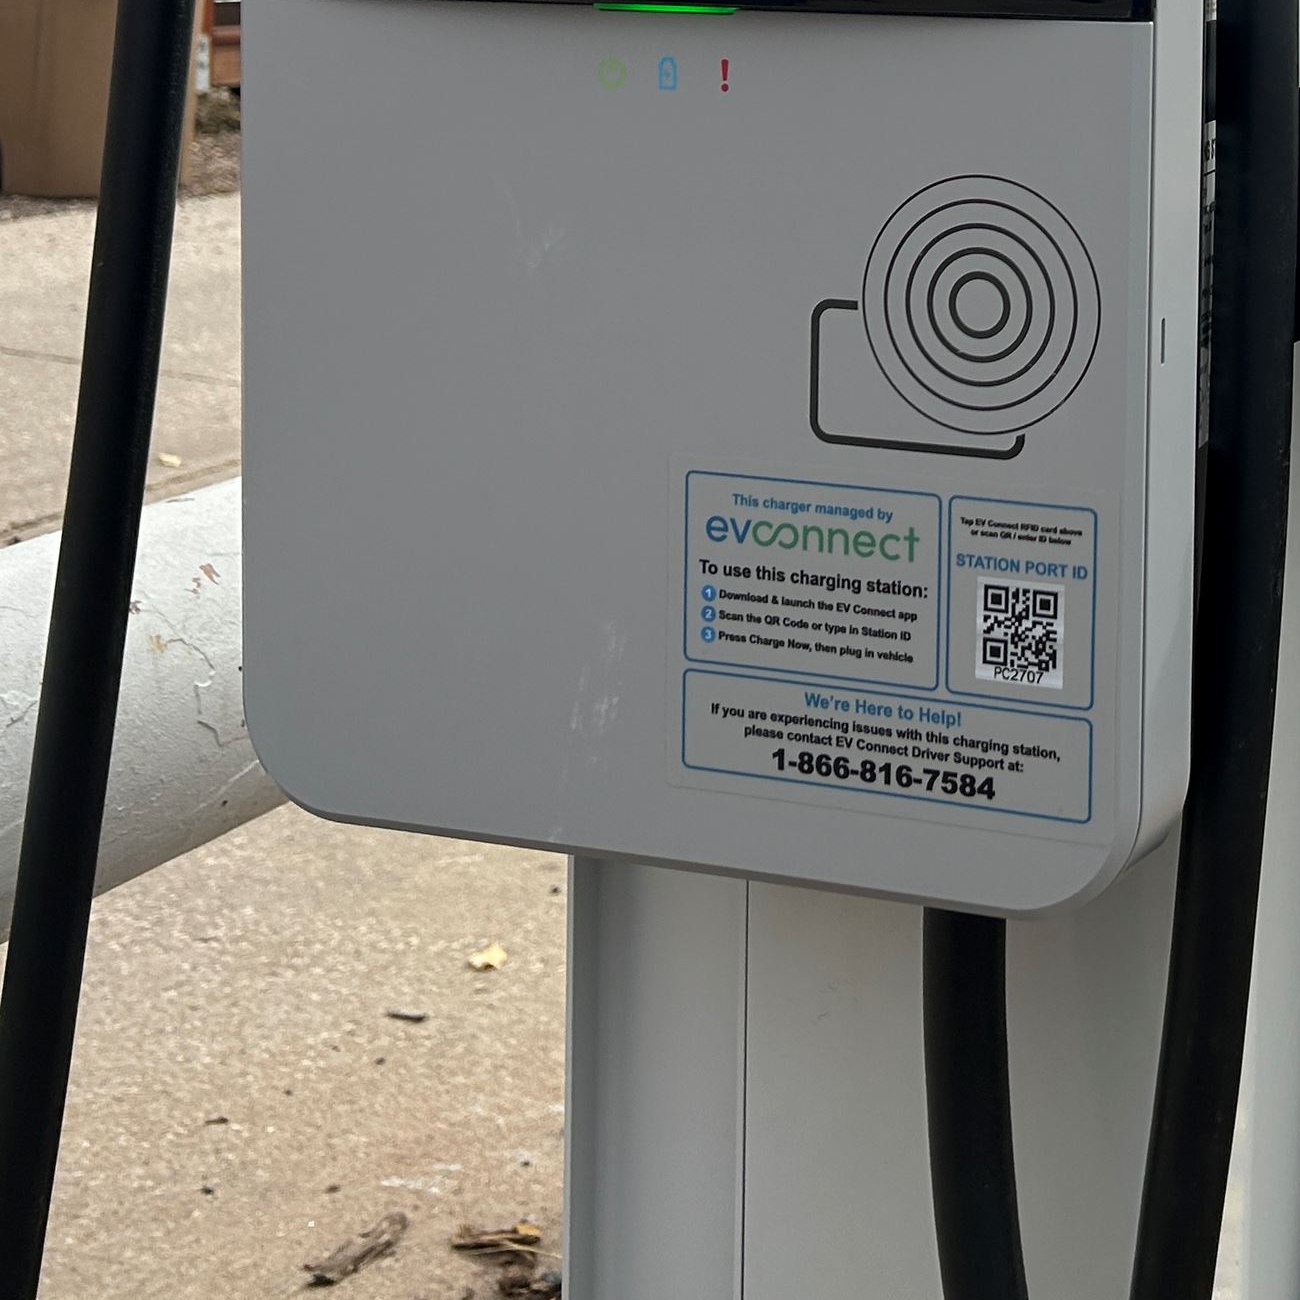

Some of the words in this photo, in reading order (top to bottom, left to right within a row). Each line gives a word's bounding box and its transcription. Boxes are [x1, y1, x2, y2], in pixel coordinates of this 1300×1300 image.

[732, 494, 760, 508] This
[762, 497, 812, 514] charger
[815, 504, 874, 520] managed
[878, 507, 894, 524] by
[706, 515, 920, 562] evconnect
[960, 516, 974, 526] Tap
[975, 518, 986, 527] EV
[988, 519, 1019, 530] Connect
[1020, 522, 1039, 532] RFID
[1041, 526, 1058, 534] card
[1060, 527, 1082, 536] above
[699, 559, 718, 576] To
[723, 564, 751, 578] use
[756, 565, 786, 582] this
[790, 569, 862, 594] charging
[866, 578, 929, 598] station:
[956, 553, 1020, 573] STATION
[1025, 560, 1068, 578] PORT
[1072, 565, 1088, 580] ID
[719, 589, 769, 604] Download
[771, 596, 779, 605] &
[781, 596, 815, 610] launch
[817, 600, 834, 612] the
[836, 602, 851, 614] EV
[853, 604, 896, 618] Connect
[898, 611, 918, 622] app
[718, 610, 744, 622] Scan
[746, 612, 762, 624] the
[764, 614, 780, 626] QR
[783, 617, 809, 630] Code
[811, 621, 823, 631] or
[824, 622, 847, 634] type
[849, 624, 859, 635] in
[861, 626, 898, 640] Station
[900, 630, 912, 641] ID
[718, 630, 746, 643] Press
[749, 634, 785, 648] Charge
[787, 638, 812, 652] Now,
[814, 642, 837, 654] then
[840, 645, 862, 658] plug
[864, 647, 874, 658] in
[877, 650, 914, 663] vehicle
[994, 666, 1044, 685] PC2707
[804, 692, 850, 712] We're
[855, 698, 893, 717] Here
[898, 704, 914, 720] to
[919, 707, 962, 728] Help!
[711, 702, 720, 714] If
[722, 706, 745, 718] you
[748, 710, 768, 720] are
[770, 713, 849, 734] experiencing
[852, 720, 892, 738] issues
[896, 726, 922, 742] with
[926, 731, 949, 745] this
[952, 734, 1009, 756] charging
[1012, 744, 1060, 762] station,
[744, 725, 784, 740] please
[787, 732, 832, 746] contact
[836, 736, 853, 748] EV
[856, 738, 908, 756] Connect
[912, 746, 950, 762] Driver
[954, 752, 1005, 770] Support
[1008, 760, 1024, 772] at:
[772, 748, 996, 800] 1-866-816-7584
